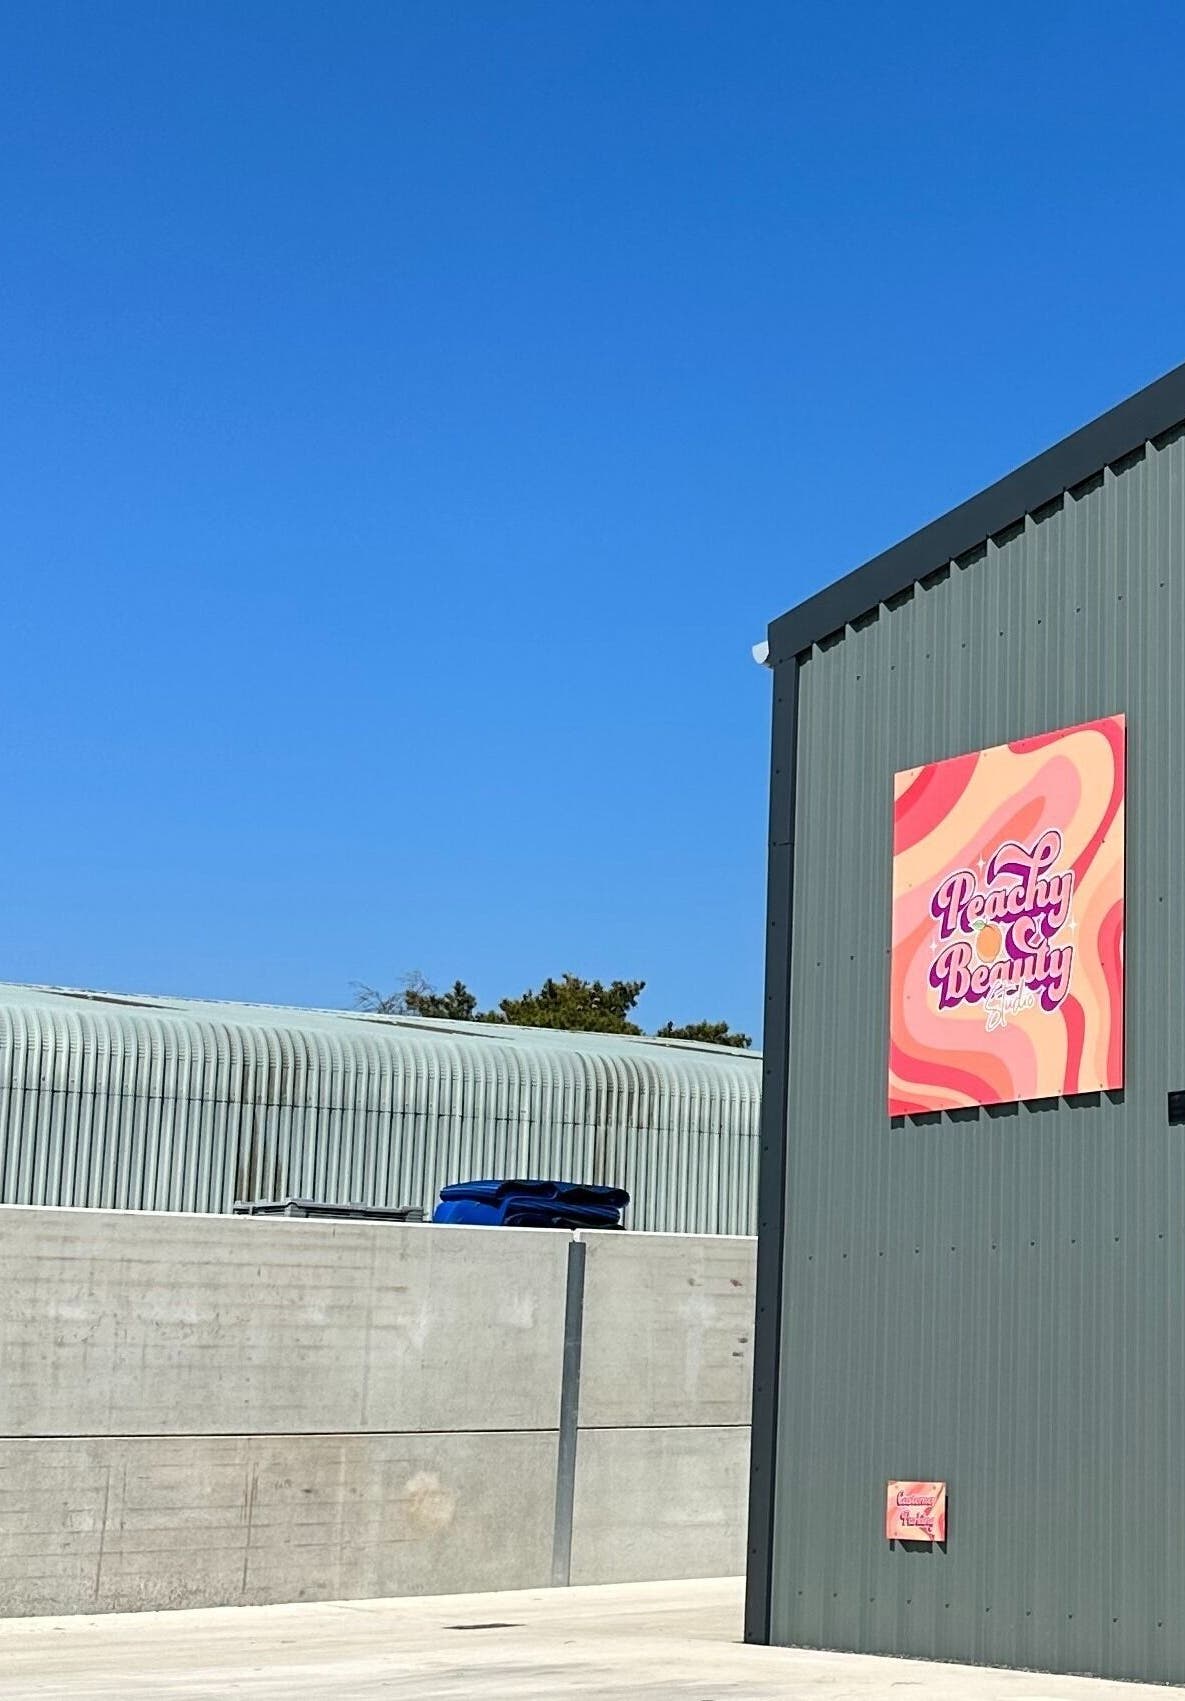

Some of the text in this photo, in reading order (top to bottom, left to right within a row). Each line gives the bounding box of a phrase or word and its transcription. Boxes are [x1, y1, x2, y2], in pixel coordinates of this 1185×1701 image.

[932, 830, 1073, 939] Peachy
[929, 915, 1074, 1011] Beauty
[985, 979, 1035, 1031] Studio
